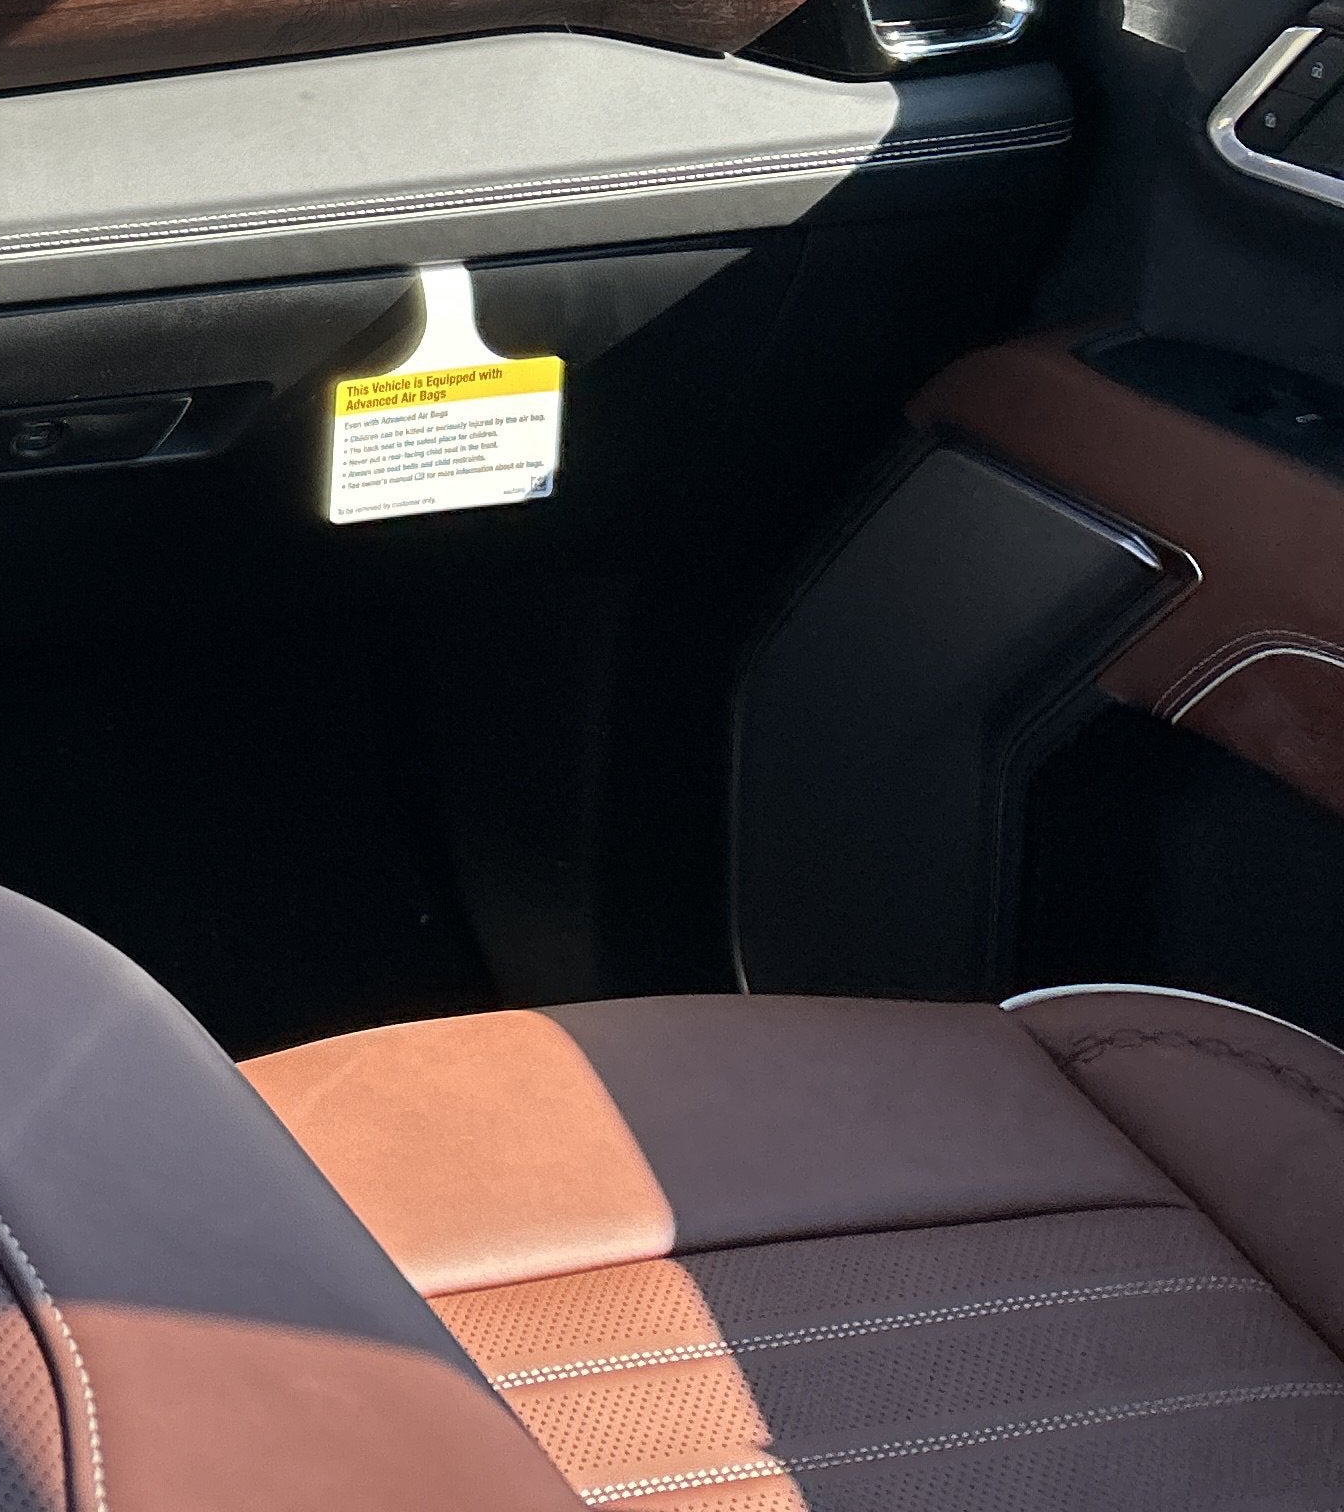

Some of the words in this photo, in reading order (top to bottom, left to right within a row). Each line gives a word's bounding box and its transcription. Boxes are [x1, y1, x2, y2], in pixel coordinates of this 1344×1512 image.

[347, 384, 369, 398] This
[372, 378, 411, 395] Vehicle
[414, 377, 423, 389] is
[426, 370, 476, 388] Equipped
[479, 367, 503, 382] with
[345, 394, 398, 412] Advanced
[401, 391, 417, 404] Air
[419, 388, 447, 403] Bags
[418, 412, 428, 420] Air
